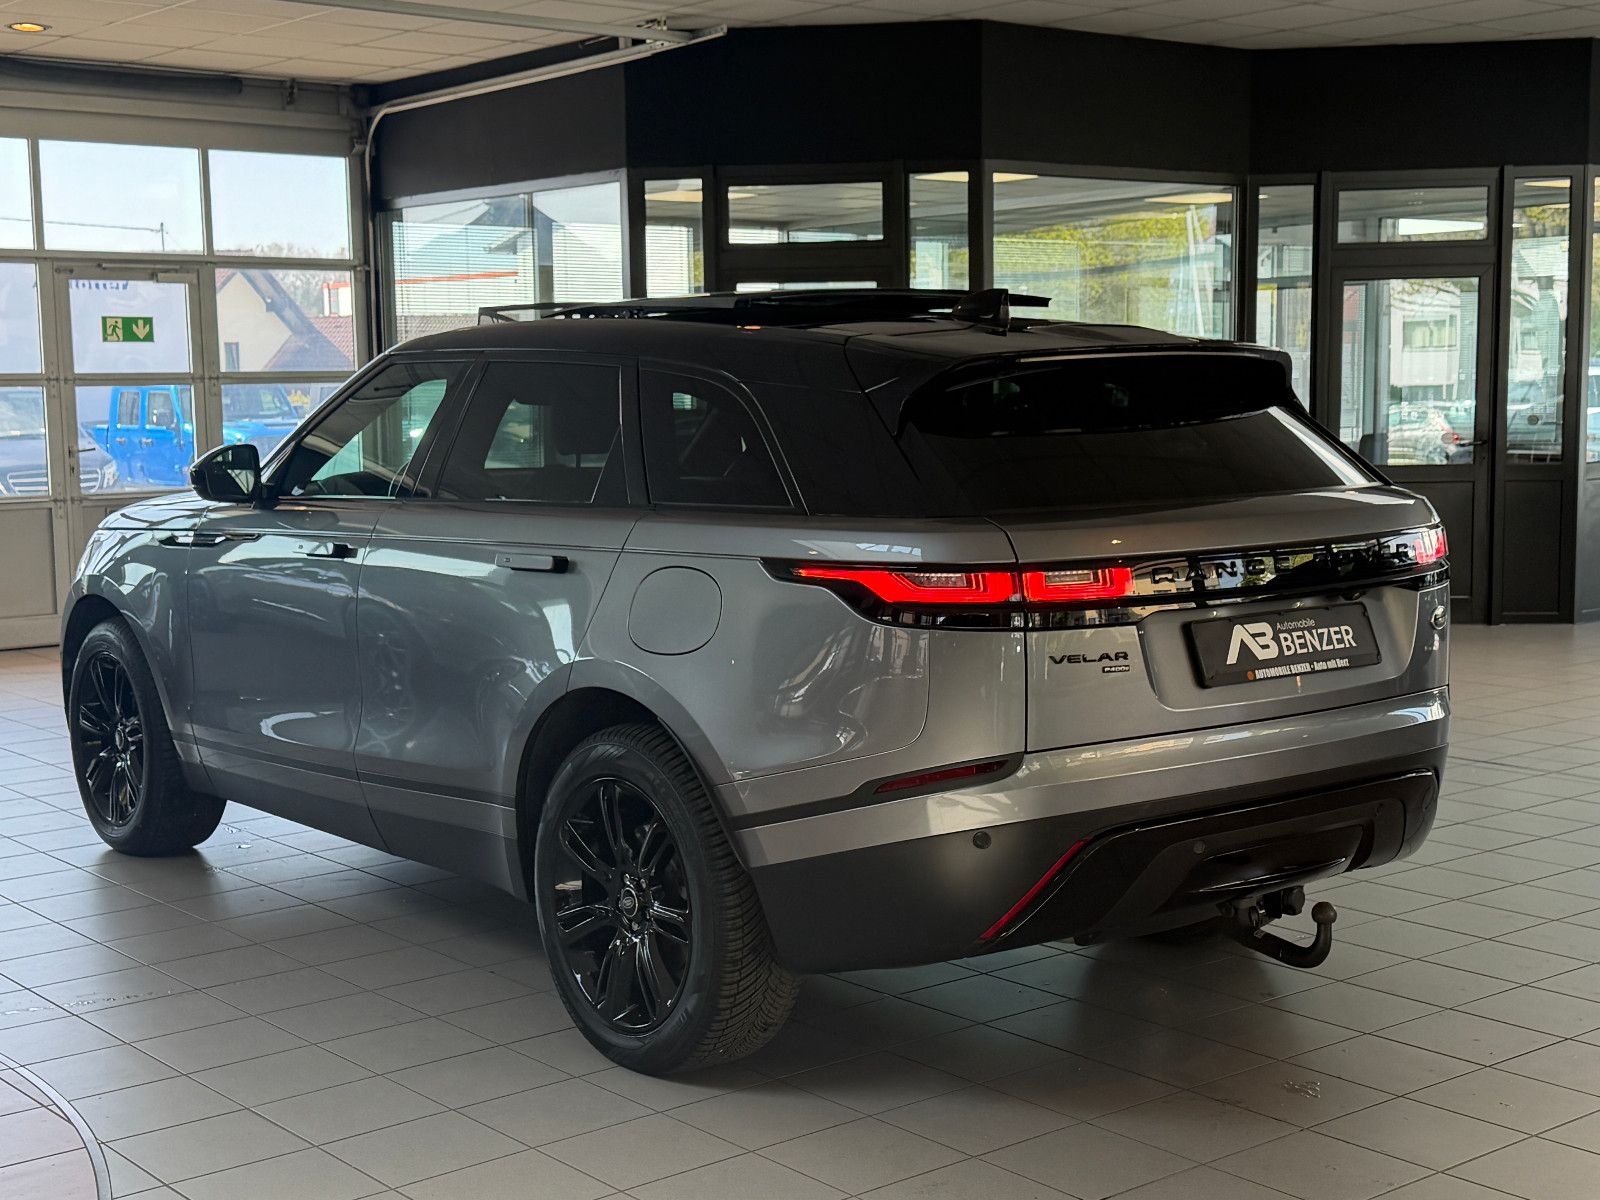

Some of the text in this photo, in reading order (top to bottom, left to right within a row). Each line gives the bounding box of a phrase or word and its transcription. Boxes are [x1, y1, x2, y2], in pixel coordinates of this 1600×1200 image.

[1276, 618, 1316, 631] Automobile
[1279, 625, 1357, 656] BENZER
[1048, 651, 1129, 665] VELAR
[1255, 664, 1290, 679] AUTOMOBILE
[1290, 662, 1312, 674] BENZER
